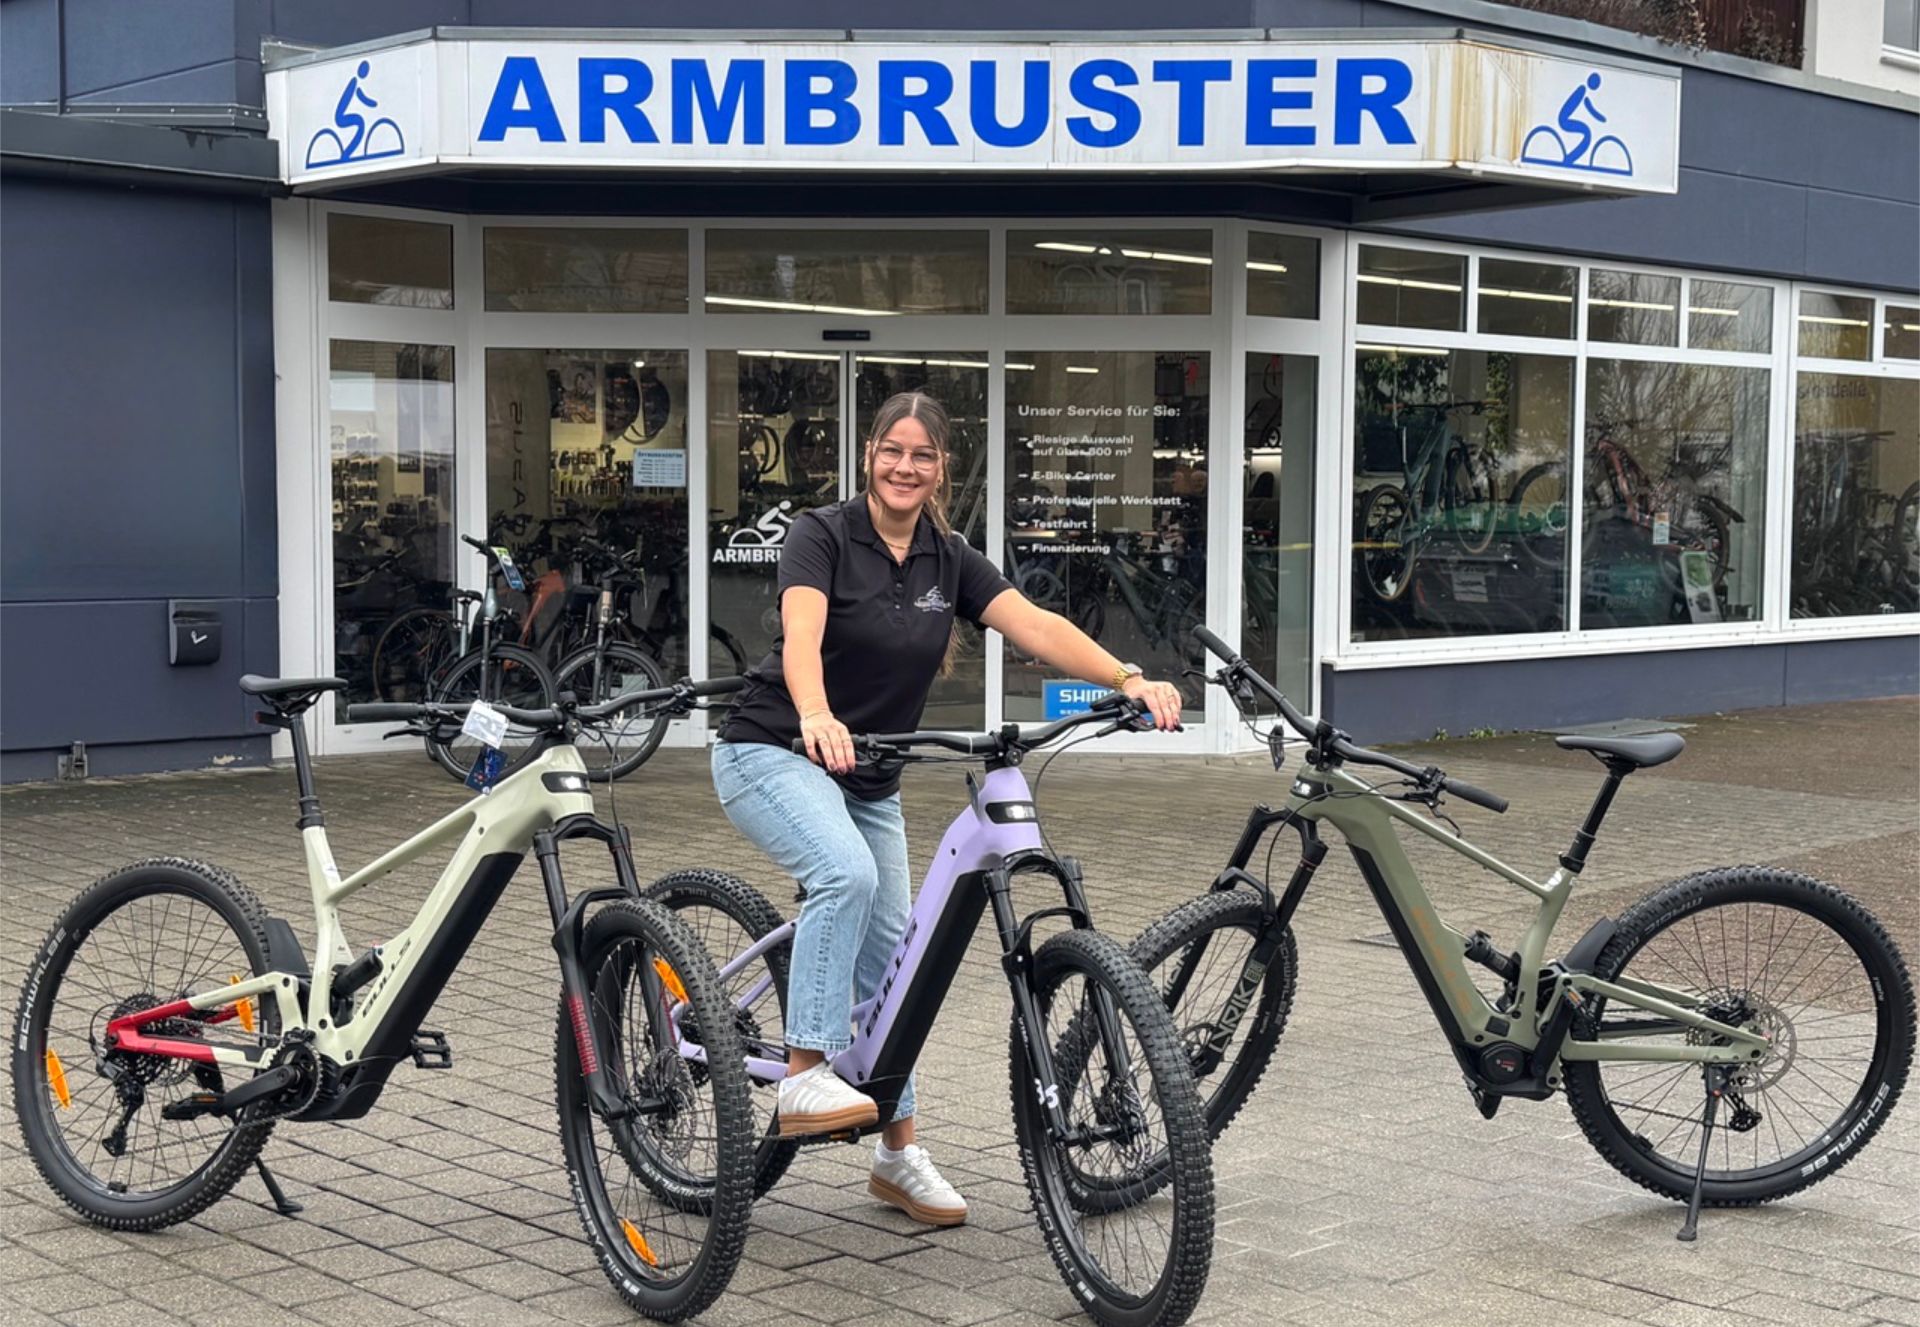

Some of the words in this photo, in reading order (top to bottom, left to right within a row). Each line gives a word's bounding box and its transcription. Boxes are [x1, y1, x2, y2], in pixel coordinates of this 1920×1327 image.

[479, 57, 1416, 148] ARMBRUSTER
[1018, 405, 1062, 417] Unser
[1067, 405, 1122, 417] Service
[1126, 404, 1149, 417] für
[1153, 405, 1180, 417] Sie:
[1033, 435, 1078, 446] Riesige
[1080, 435, 1134, 445] Auswahl
[1032, 447, 1053, 457] auf
[1115, 447, 1132, 457] m²
[1031, 471, 1073, 481] E-Bike
[1074, 471, 1116, 481] Center
[1032, 495, 1117, 506] Professionelle
[1120, 495, 1182, 506] Werkstatt
[1032, 519, 1088, 529] Testfahrt
[1032, 543, 1111, 555] Finanzierung
[865, 917, 918, 1039] BULLS
[18, 926, 67, 1052] SCHWALBE
[1208, 980, 1258, 1053] LYRIK
[1800, 1081, 1891, 1178] SCHWALBE
